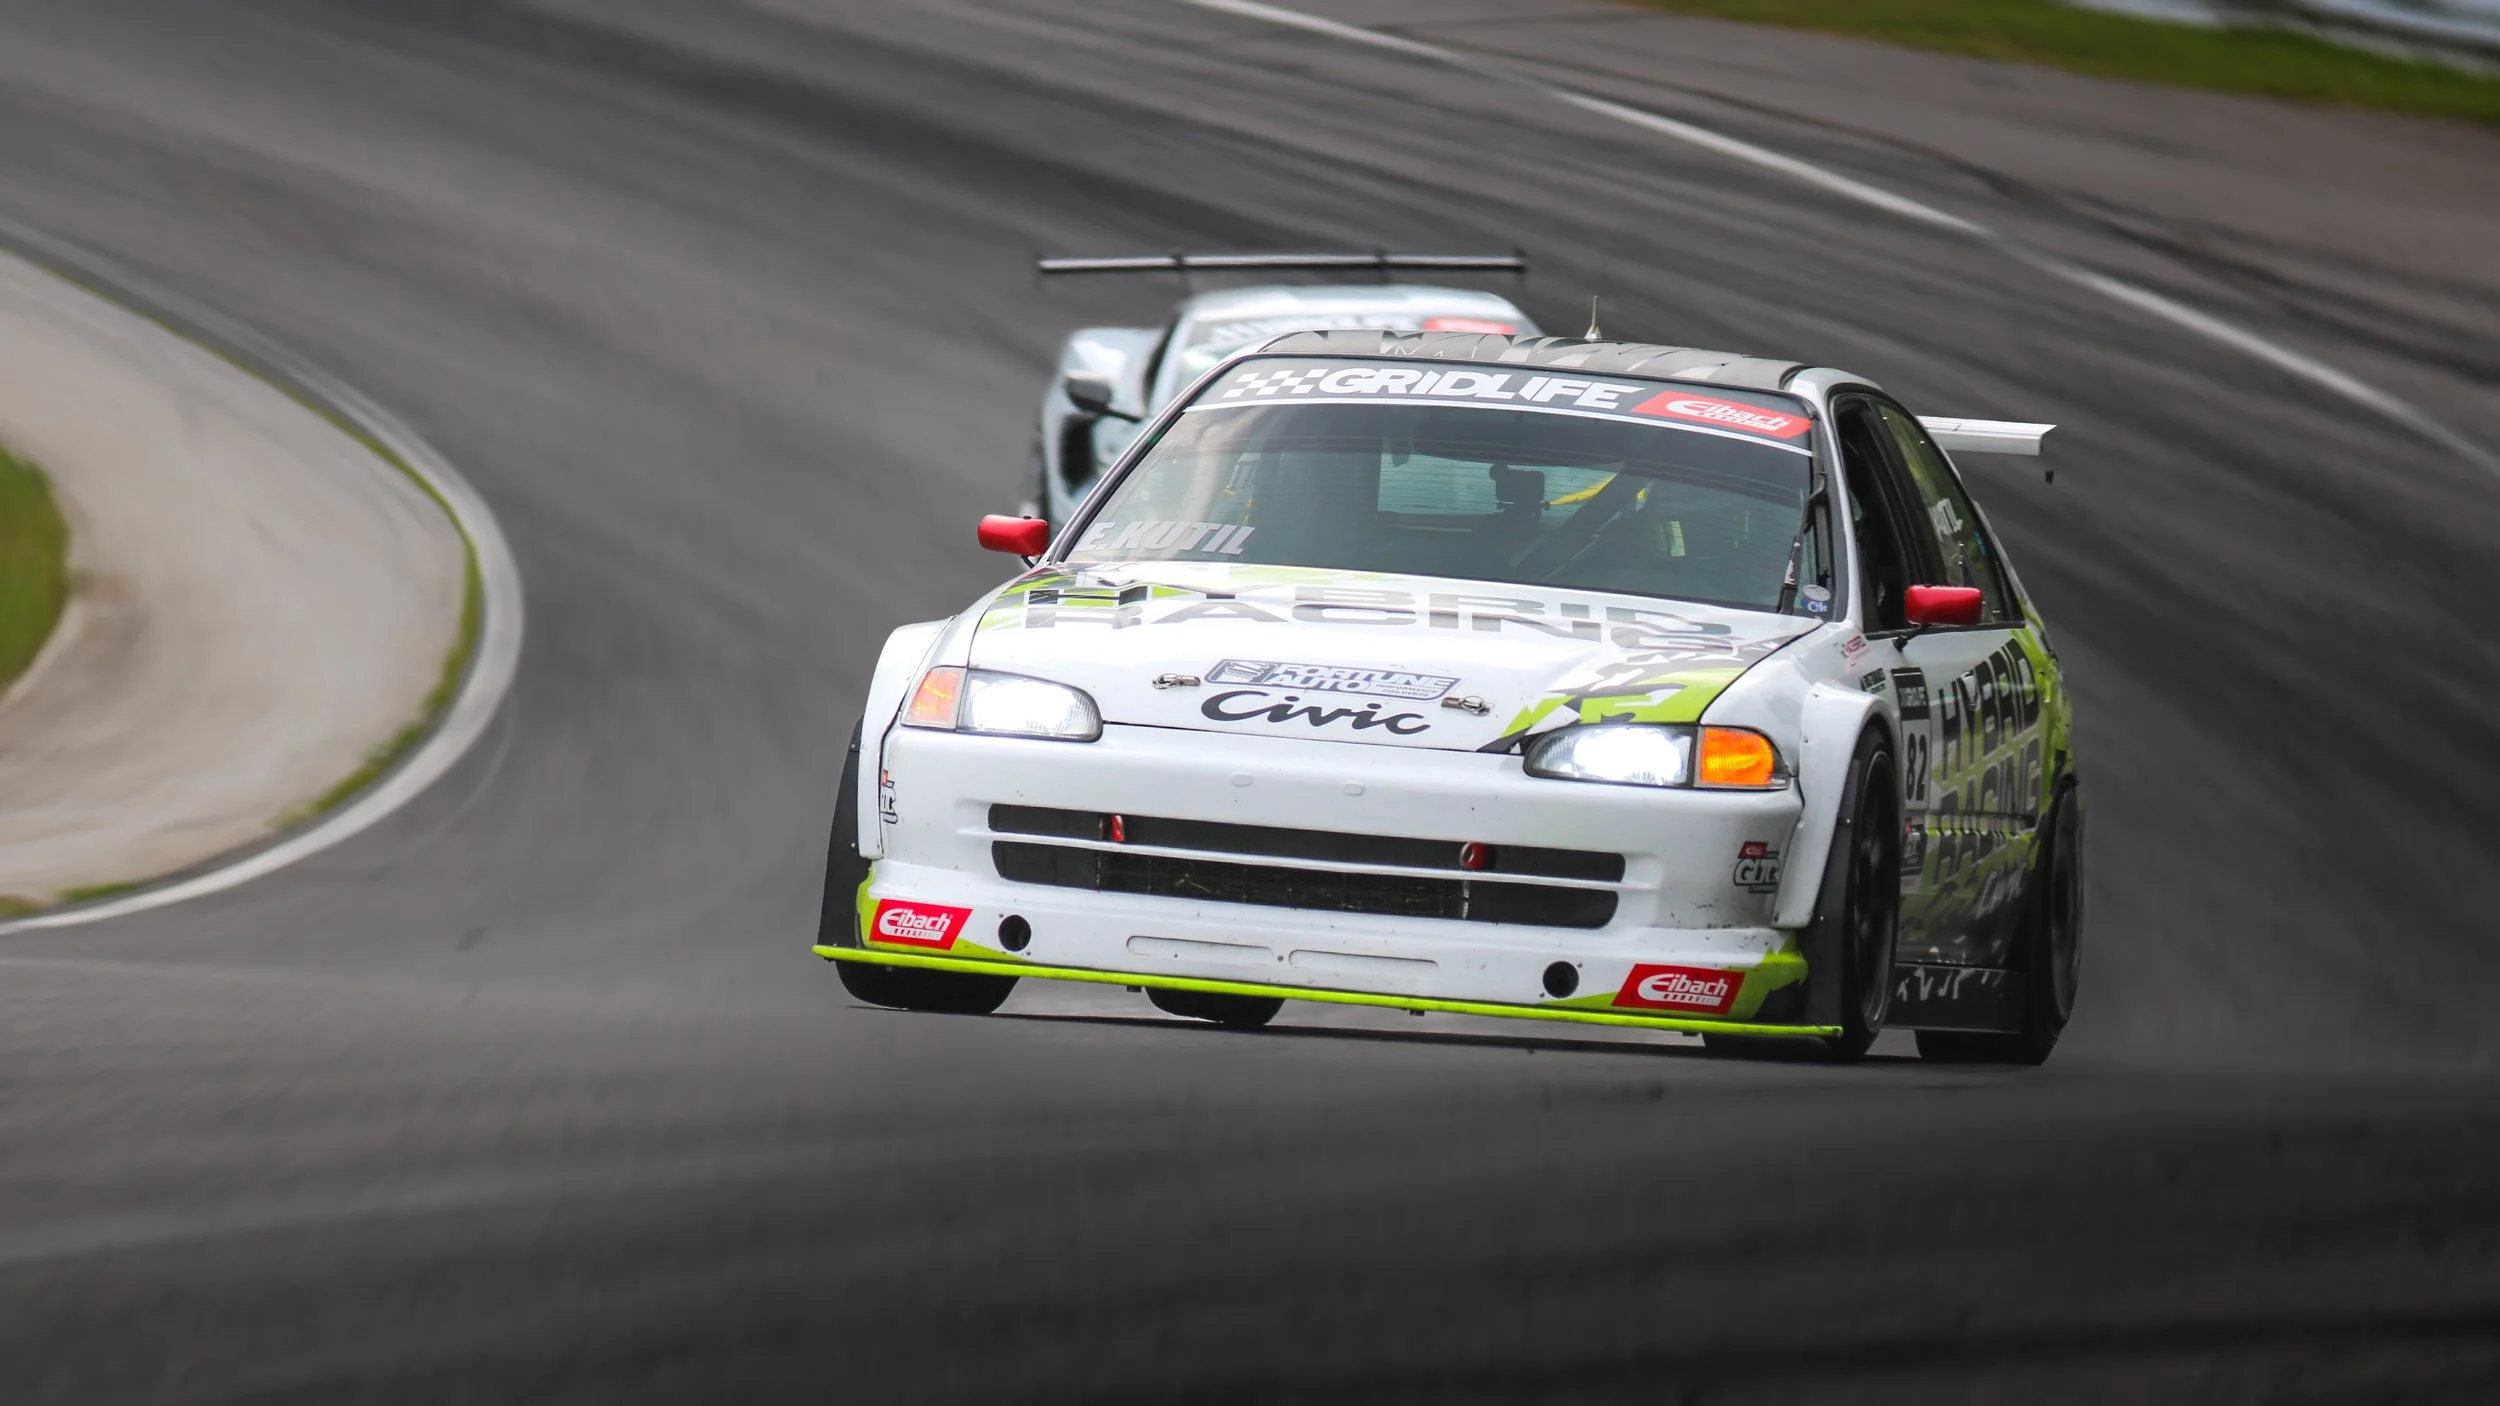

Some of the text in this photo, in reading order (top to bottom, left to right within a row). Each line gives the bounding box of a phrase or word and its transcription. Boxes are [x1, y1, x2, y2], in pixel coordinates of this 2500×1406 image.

[1318, 367, 1646, 410] GRIDLIFE
[1665, 400, 1792, 431] Eibach
[1024, 601, 1740, 656] RACING
[1027, 584, 1733, 635] HYBRID
[1262, 673, 1371, 692] AUTO
[1273, 663, 1456, 688] FORTUNE
[1200, 690, 1431, 735] Civic
[1937, 638, 2041, 781] HYBRID
[1905, 732, 1928, 801] 82
[879, 908, 952, 941] Eibach
[1638, 973, 1729, 1006] Eibach
